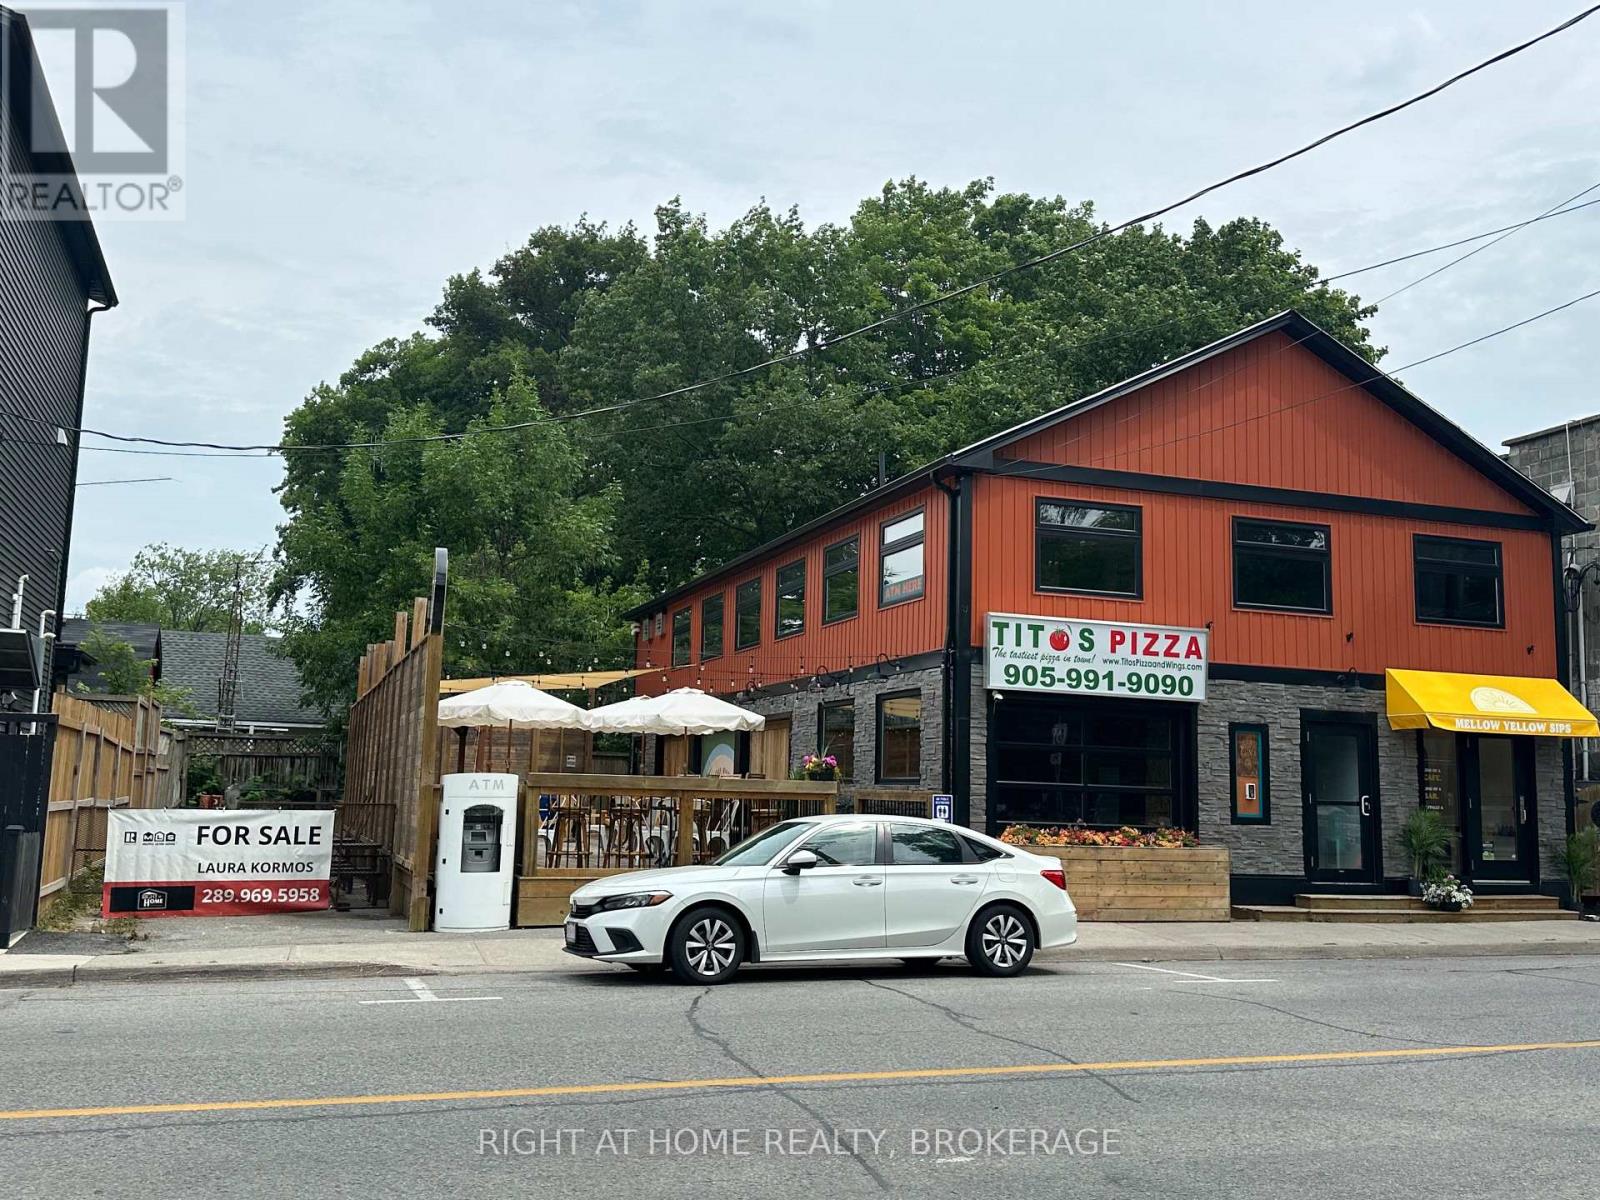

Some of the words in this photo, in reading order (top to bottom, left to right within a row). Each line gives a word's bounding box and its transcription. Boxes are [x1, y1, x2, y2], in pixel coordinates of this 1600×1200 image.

[1109, 629, 1203, 660] PIZZA
[992, 646, 1007, 658] The
[1009, 650, 1039, 661] tastiest
[1039, 653, 1061, 665] pizza
[1063, 654, 1073, 663] in
[1074, 654, 1096, 665] town!
[1102, 657, 1203, 672] www.TitosPizzaandWings.com
[1003, 664, 1194, 697] 905-991-9090
[1455, 718, 1501, 731] MELLOW
[1503, 720, 1547, 733] YELLOW
[1549, 723, 1572, 734] SIPS
[468, 778, 505, 791] ATM
[196, 825, 250, 846] FOR
[258, 825, 322, 846] SALE
[197, 862, 247, 874] LAURA
[251, 861, 314, 874] KORMOS
[201, 887, 320, 903] 289.969.5958
